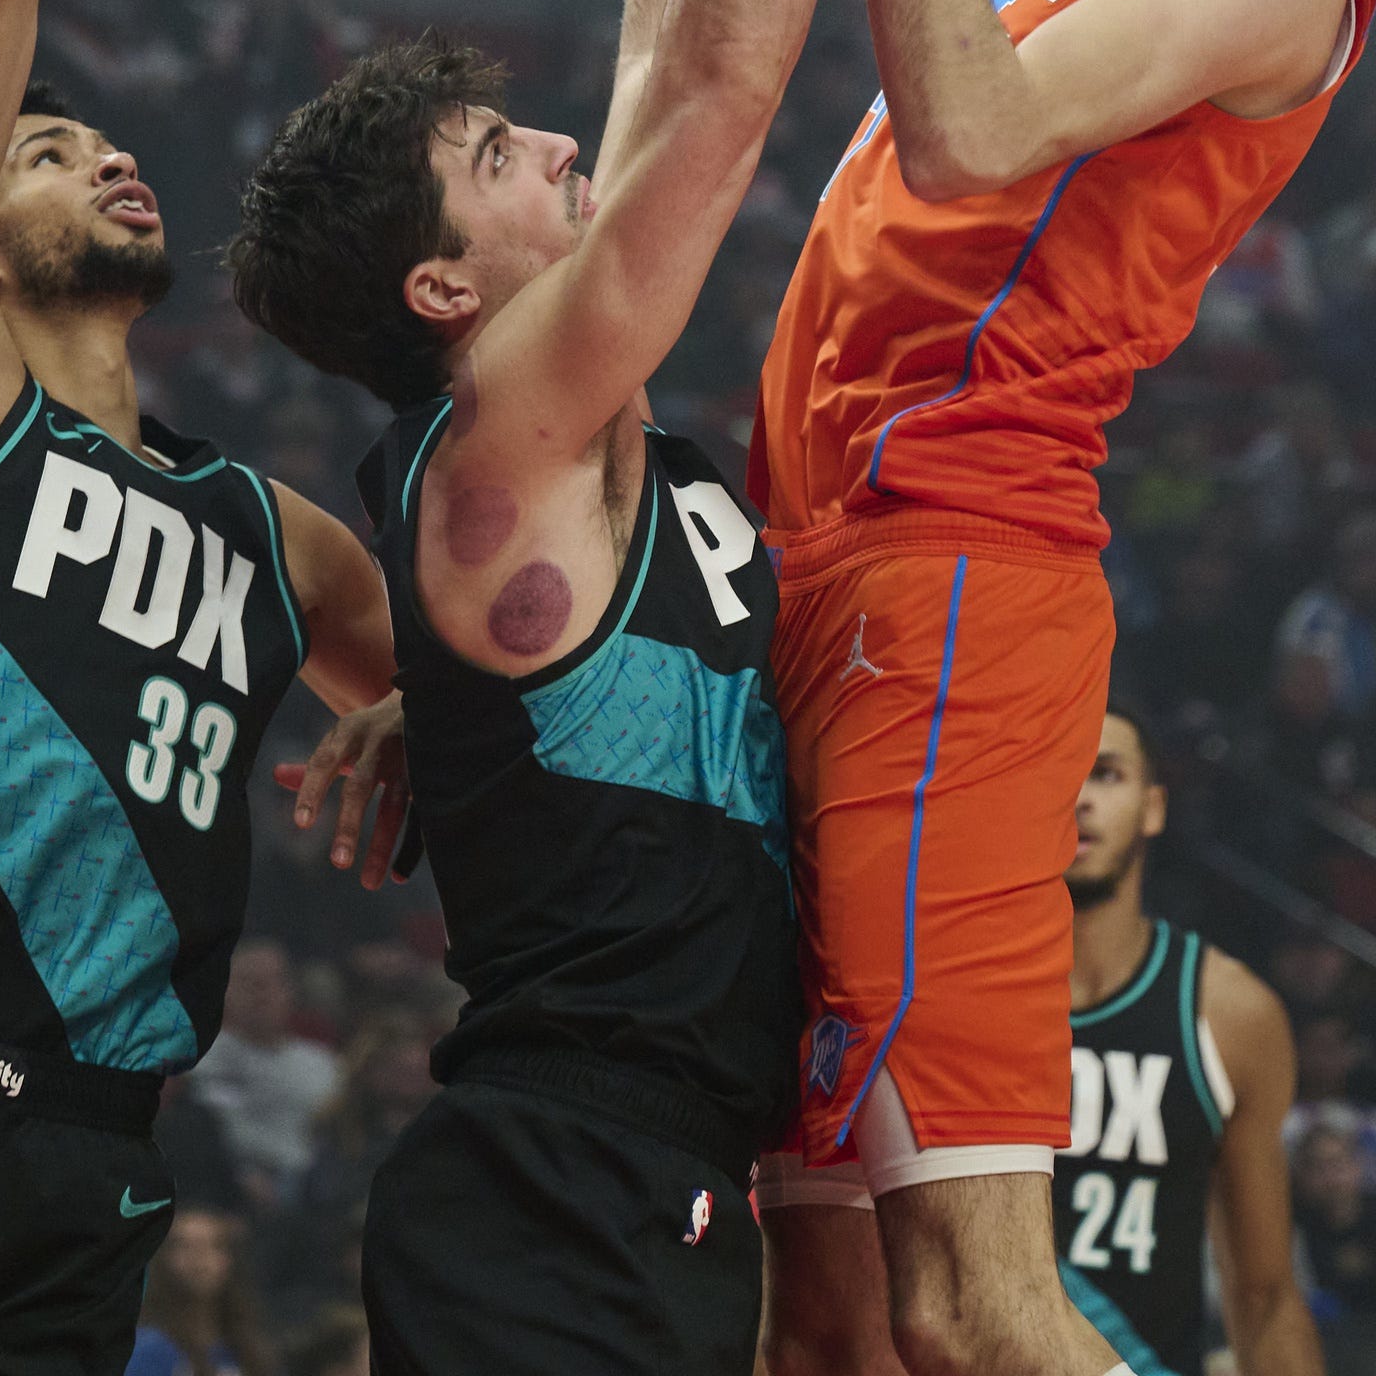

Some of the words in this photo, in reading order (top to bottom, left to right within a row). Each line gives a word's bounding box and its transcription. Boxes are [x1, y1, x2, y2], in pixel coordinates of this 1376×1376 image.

[12, 450, 255, 696] PDX
[126, 675, 237, 832] 33
[1069, 1173, 1158, 1273] 24
